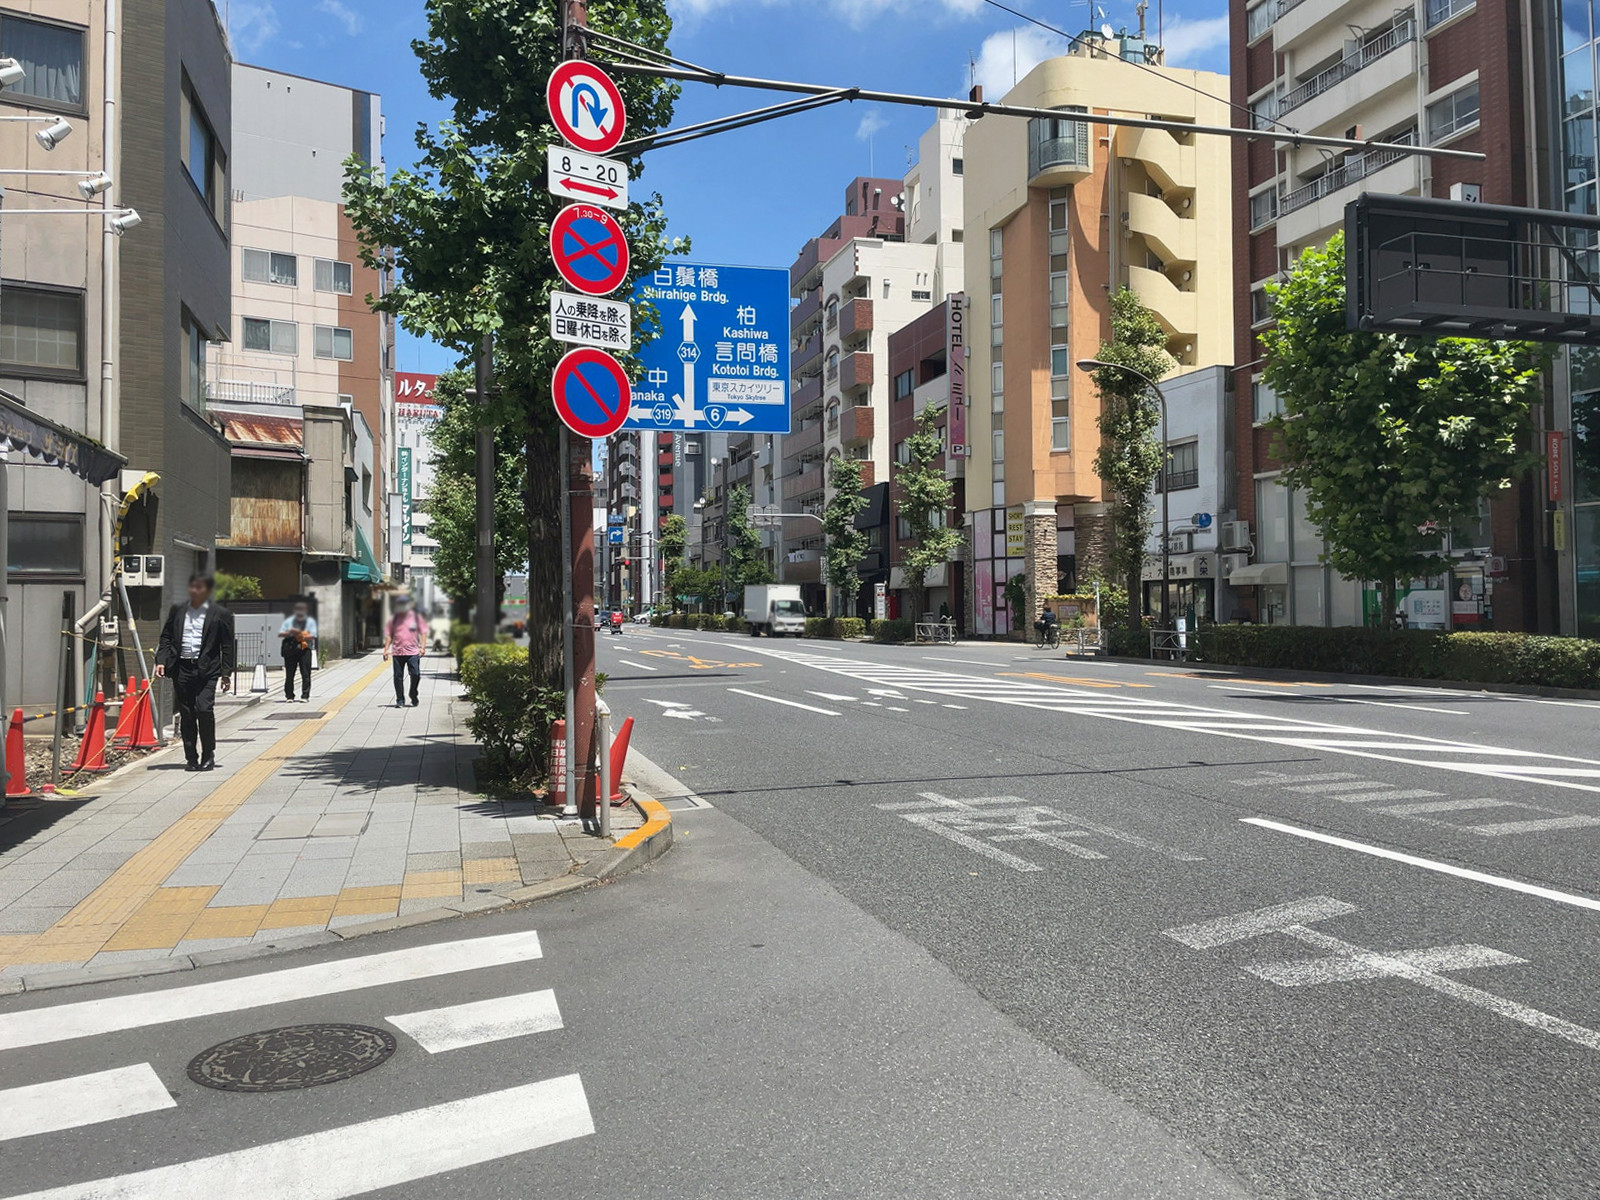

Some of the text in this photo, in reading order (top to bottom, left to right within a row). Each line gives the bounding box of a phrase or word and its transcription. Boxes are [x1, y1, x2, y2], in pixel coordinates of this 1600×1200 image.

[701, 290, 730, 304] Brdg.
[555, 298, 626, 325] 人の乗降を除く
[736, 305, 756, 326] 柏
[951, 300, 962, 352] HOTEL
[723, 326, 769, 340] Kashiwa
[680, 346, 698, 359] 314
[714, 341, 778, 364] 言問橋
[712, 363, 779, 379] Kototoi Brdg.
[712, 382, 781, 394] 東京スカイツリー
[631, 390, 665, 402] anaka
[727, 394, 744, 402] Tokyo
[654, 403, 672, 417] 319
[710, 409, 721, 422] 6
[954, 445, 963, 453] P
[1008, 523, 1023, 531] REST
[1008, 534, 1023, 543] STAY
